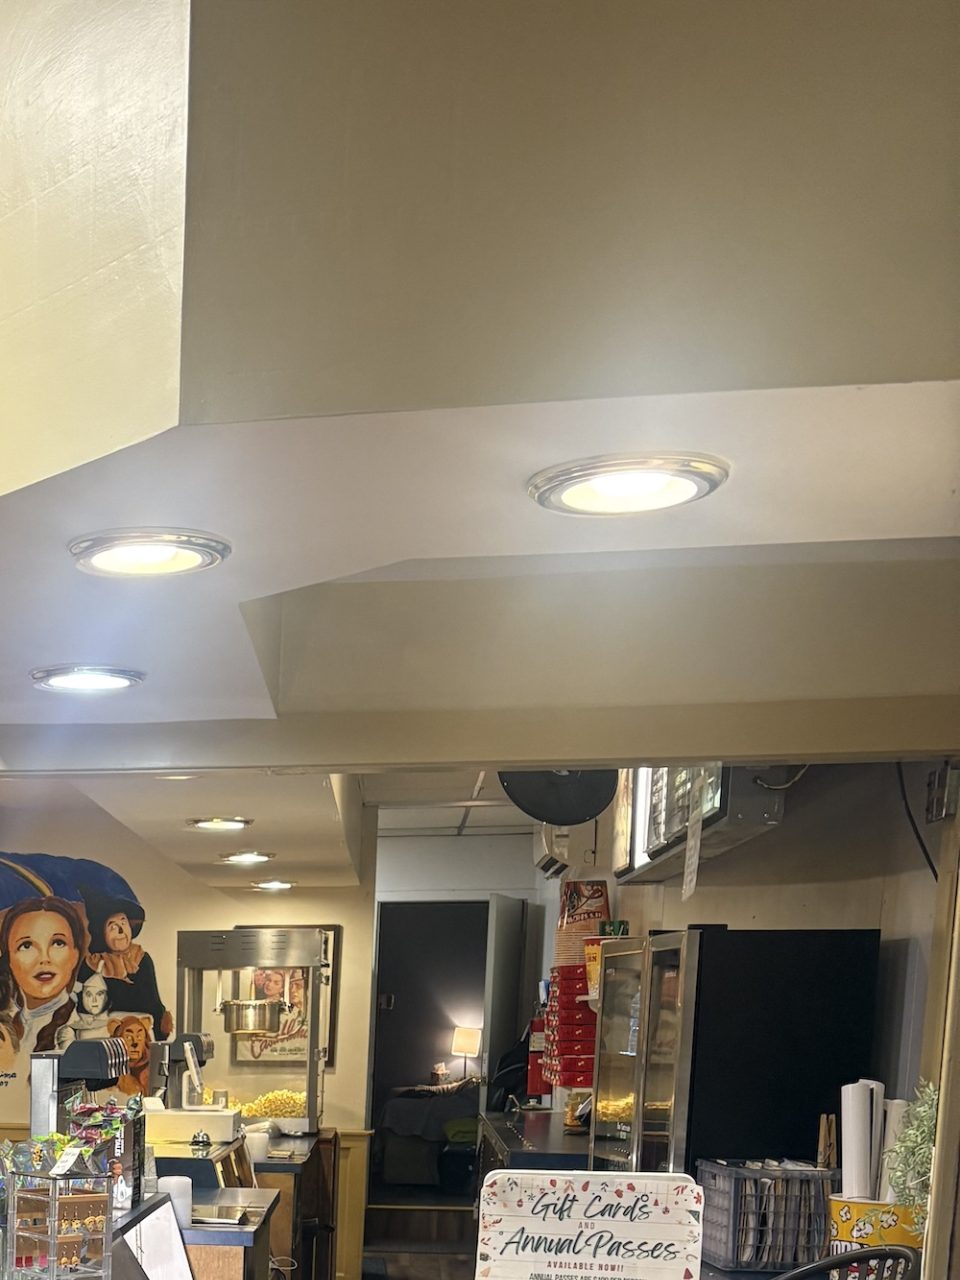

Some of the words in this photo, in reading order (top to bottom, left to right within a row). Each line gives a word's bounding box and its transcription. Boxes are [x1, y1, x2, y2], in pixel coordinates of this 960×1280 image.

[531, 1192, 578, 1221] Gift
[583, 1194, 653, 1222] Cards
[500, 1226, 585, 1255] Annual
[585, 1230, 680, 1261] Passes
[547, 1261, 594, 1270] AVAILABLE
